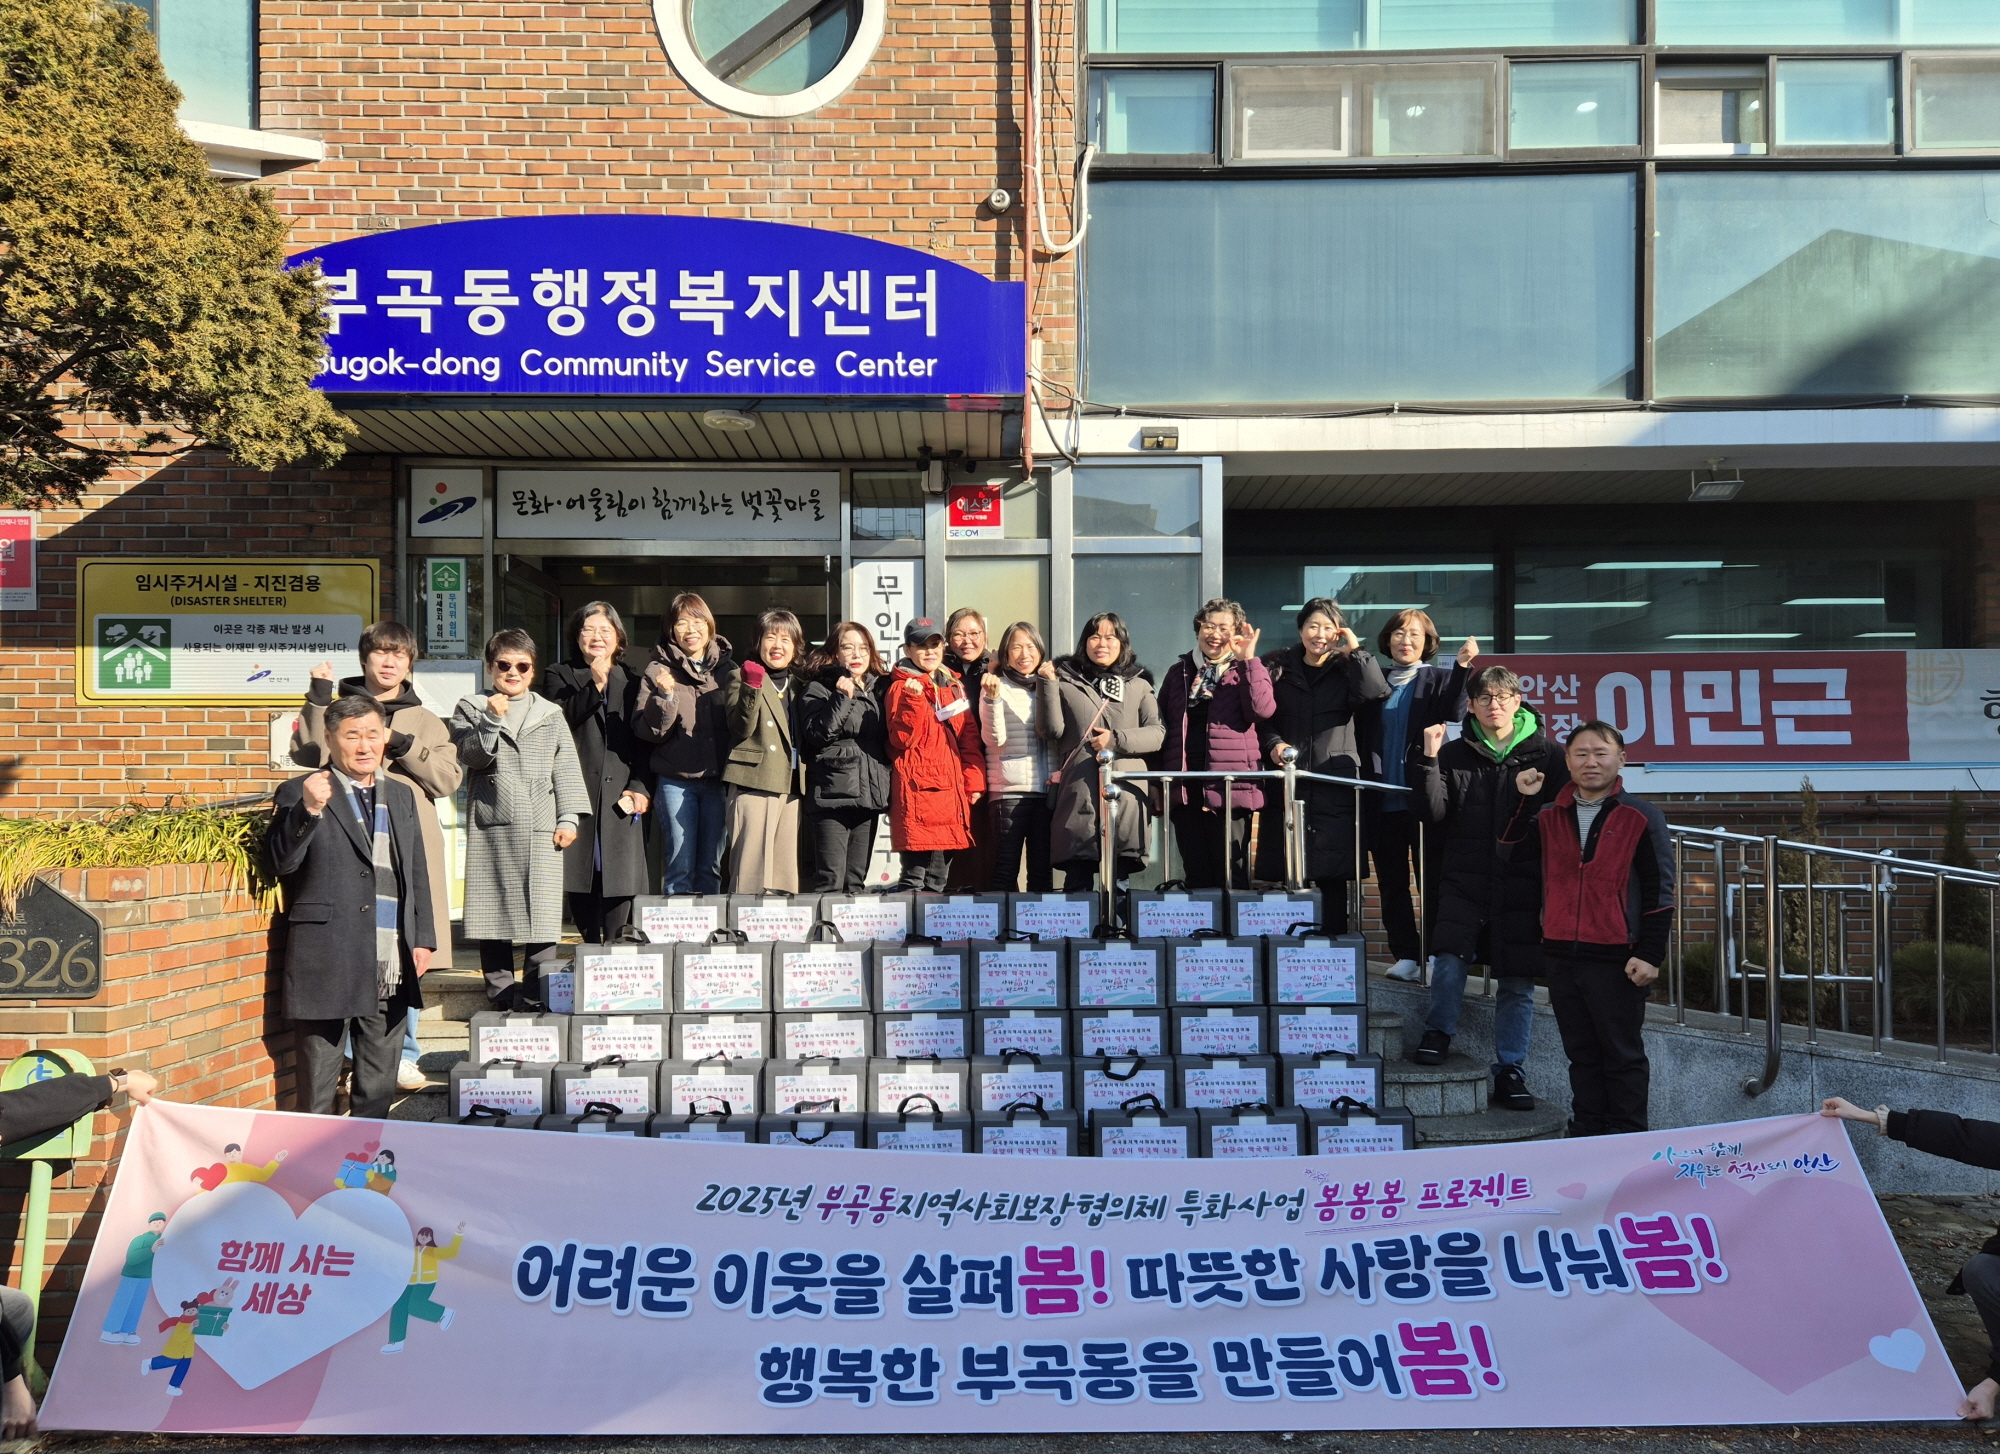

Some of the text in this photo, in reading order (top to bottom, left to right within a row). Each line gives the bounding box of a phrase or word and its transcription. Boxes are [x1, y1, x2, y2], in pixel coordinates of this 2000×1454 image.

[315, 268, 936, 337] 부곡동행정복지센터
[316, 348, 937, 382] ugok-dong Community Service Center
[957, 498, 992, 511] 에스원
[949, 529, 978, 537] SECOM
[135, 574, 237, 592] 임시주거시설
[253, 574, 321, 592] 지진겸용
[170, 596, 287, 607] (DISASTER SHELTER)
[448, 593, 456, 619] 무더위
[213, 624, 324, 635] 이곳은 각종 재난 발생 시
[182, 642, 350, 653] 사용되는 이재민 임시주거시설입니다.
[1519, 674, 1581, 705] 안산
[1595, 669, 1852, 746] 이민근
[0, 937, 96, 988] 326
[1793, 1153, 1840, 1174] 안산
[696, 1174, 1533, 1228] 2025년 부곡동지역사회보장협의체 특화사업 봉봉봉 프로젝트
[217, 1240, 355, 1277] 함께 사는
[517, 1213, 1725, 1315] 어려운 이웃을 살펴봄! 따뜻한 사랑을 나눠봄!
[241, 1281, 312, 1315] 세상
[759, 1320, 1501, 1403] 행복한 부곡동을 만들어봄!
